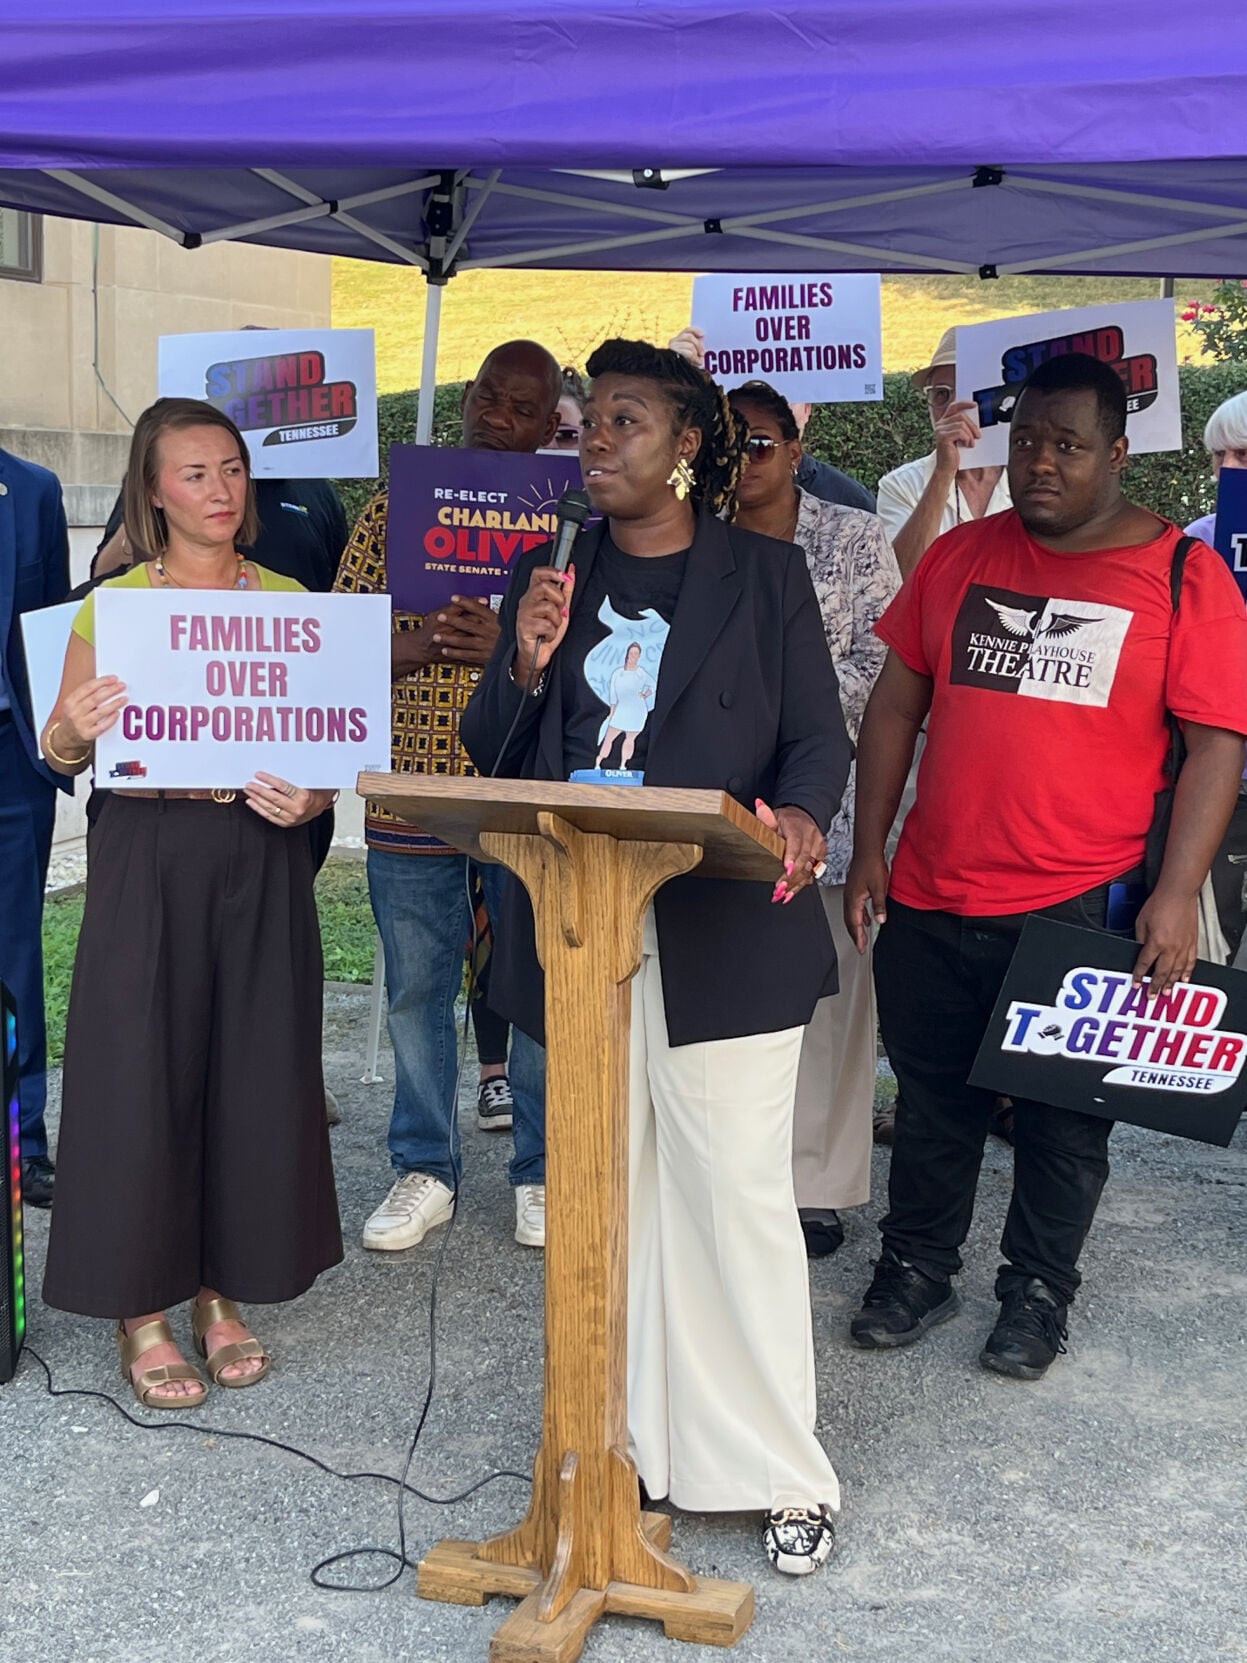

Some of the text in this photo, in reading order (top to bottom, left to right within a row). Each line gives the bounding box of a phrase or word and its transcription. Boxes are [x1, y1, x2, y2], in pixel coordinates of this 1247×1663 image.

[732, 282, 833, 312] FAMILIES
[755, 315, 810, 342] OVER
[704, 343, 866, 375] CORPORATIONS
[208, 353, 322, 397] STAND
[279, 424, 340, 442] TENNESSEE
[434, 487, 508, 503] RE-ELECT
[425, 562, 501, 576] STATE SENATE
[170, 614, 321, 653] FAMILIES
[969, 633, 1097, 664] KENNIE PLAYHOUSE
[206, 660, 288, 697] OVER
[966, 646, 1093, 688] THEATRE
[123, 705, 368, 743] CORPORATIONS
[1064, 972, 1219, 1028] STAND
[1131, 1069, 1214, 1090] TENNESSEE
